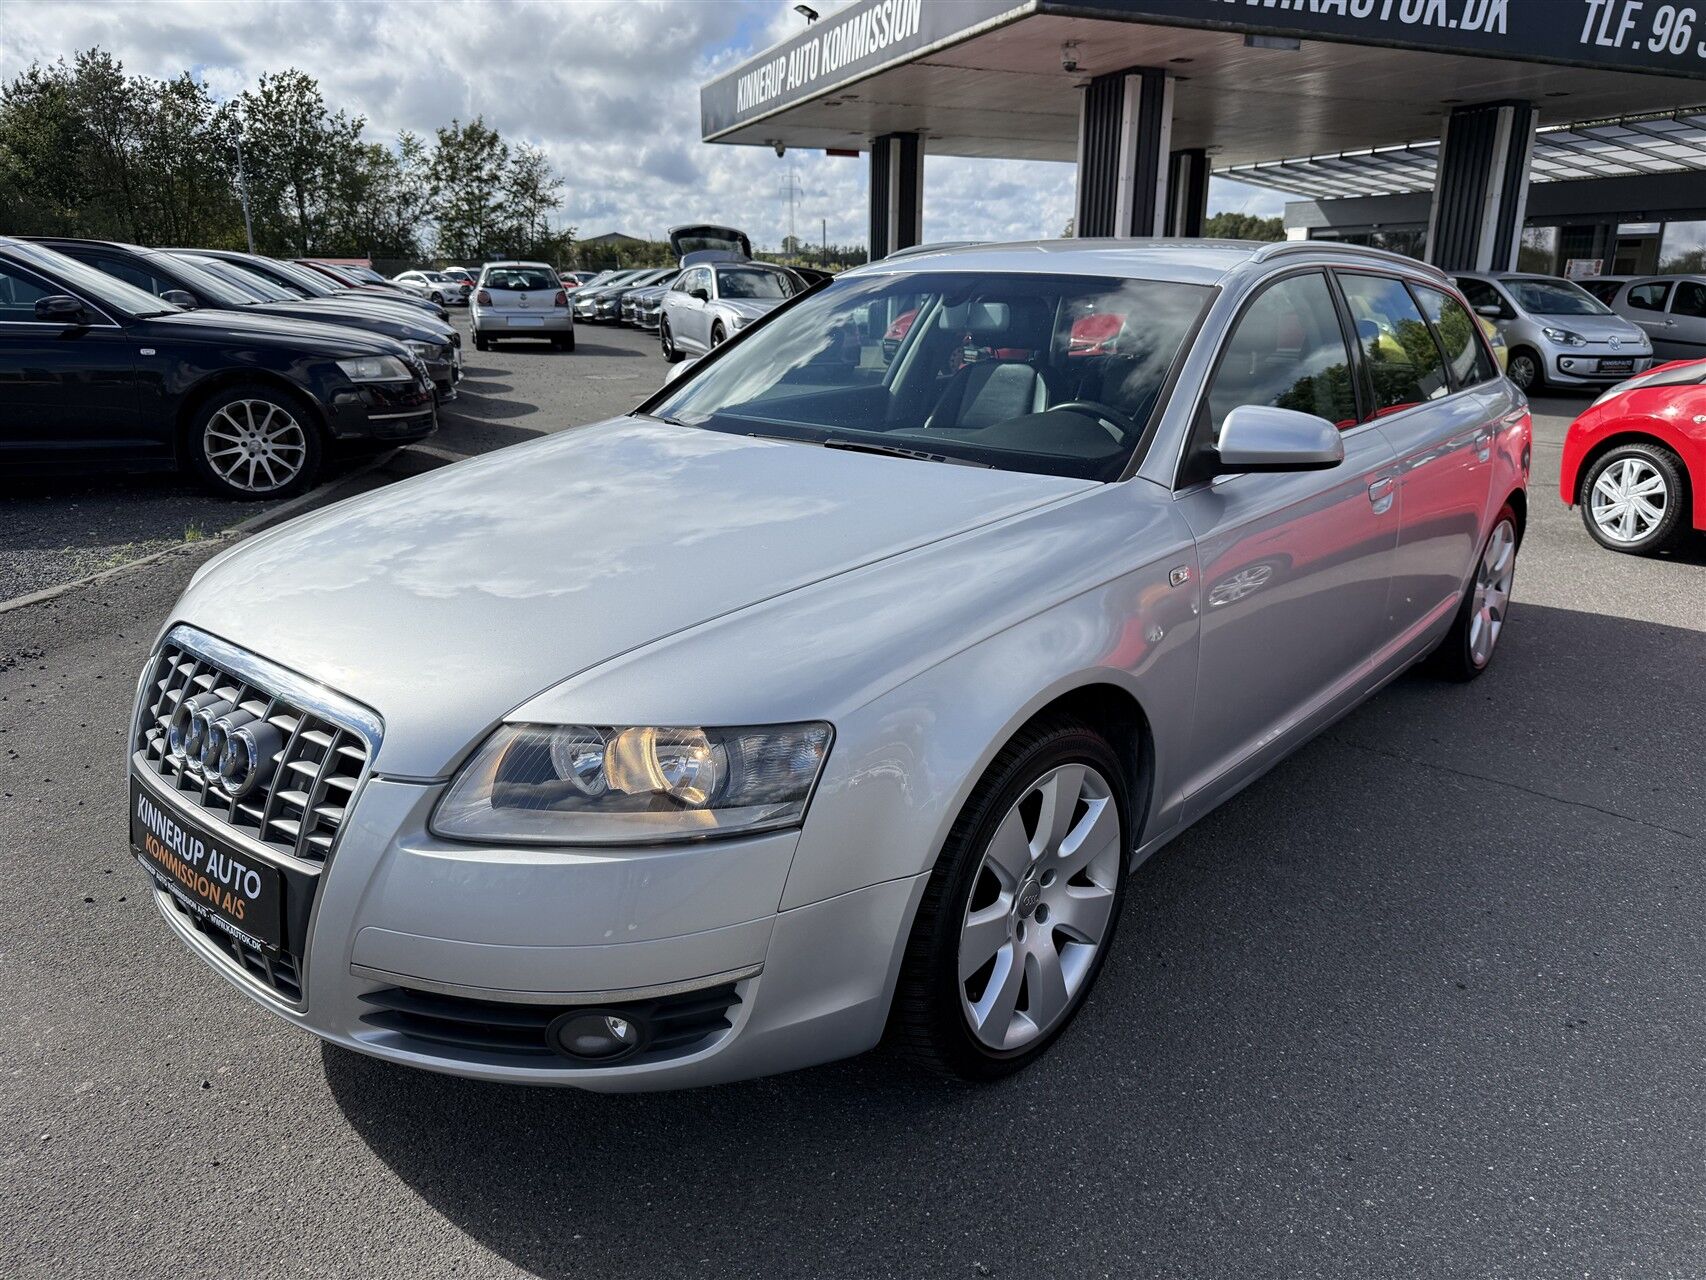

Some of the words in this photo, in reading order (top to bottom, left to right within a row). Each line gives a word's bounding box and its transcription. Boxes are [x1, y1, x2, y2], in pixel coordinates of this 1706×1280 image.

[737, 56, 786, 113] KINNERUP
[786, 38, 820, 91] AUTO
[821, 0, 921, 76] KOMMISSION
[1580, 0, 1643, 50] TLF.
[1648, 5, 1697, 55] 96
[137, 793, 204, 865] KINNERUP
[206, 849, 261, 899] AUTO
[145, 832, 220, 905] KOMMISSION
[222, 892, 245, 920] A/S
